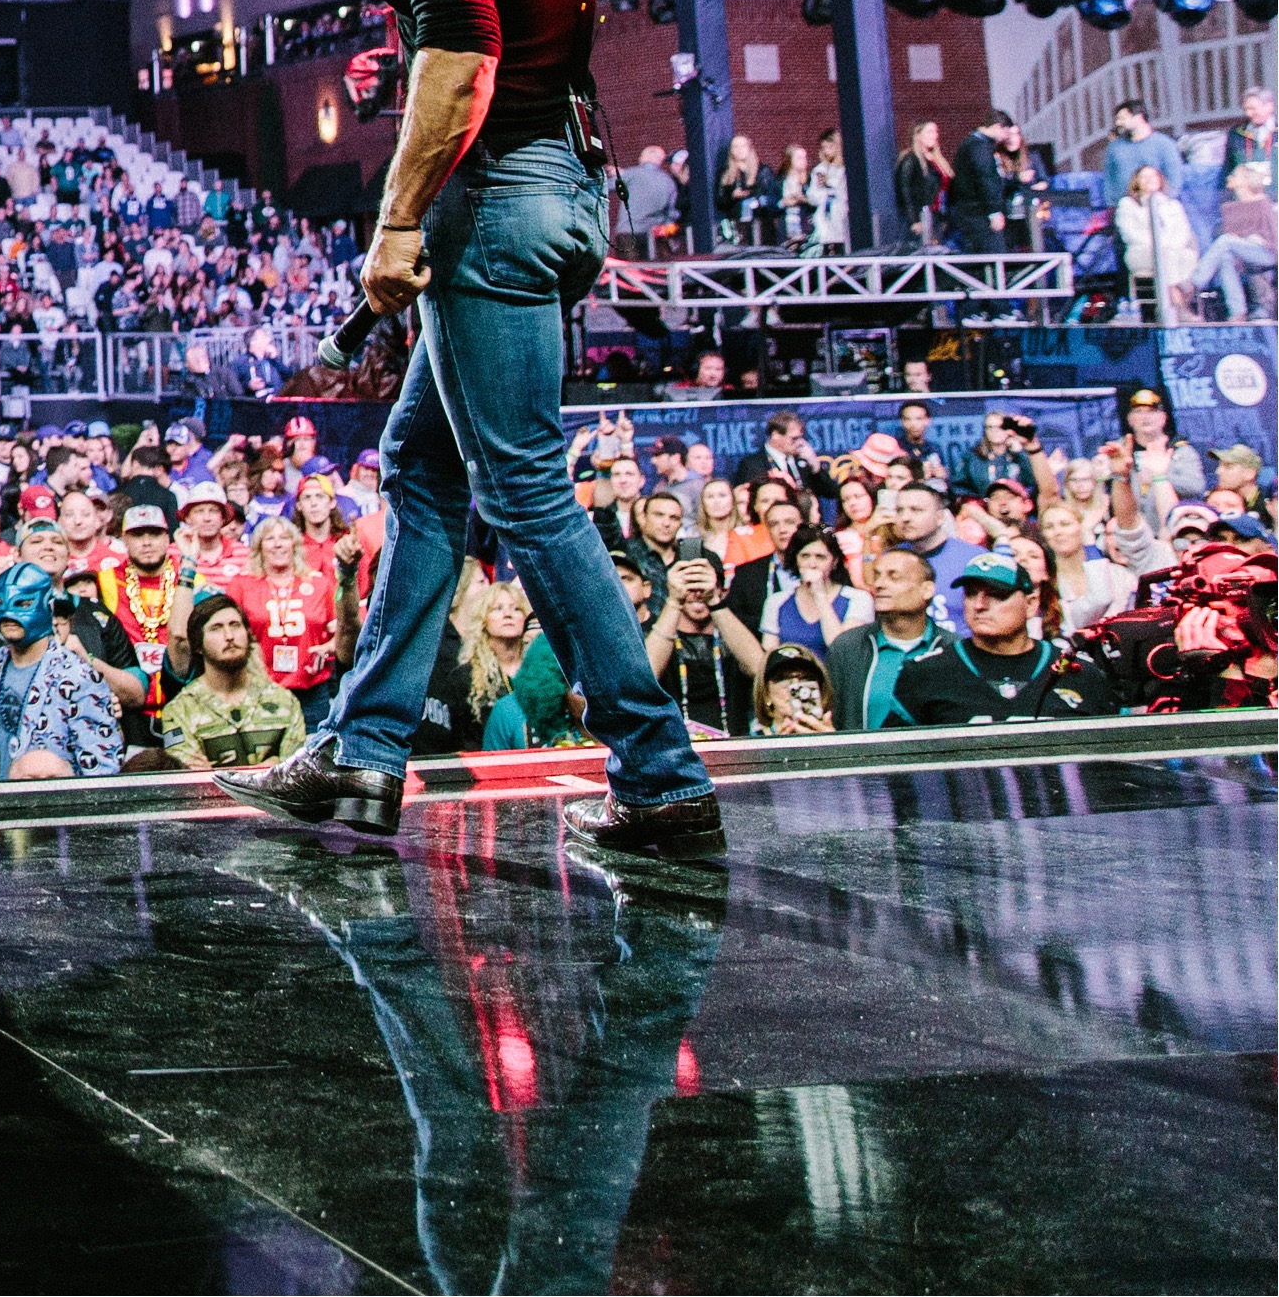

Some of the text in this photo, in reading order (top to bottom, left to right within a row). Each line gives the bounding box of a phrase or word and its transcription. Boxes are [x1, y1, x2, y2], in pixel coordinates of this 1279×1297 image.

[702, 416, 872, 454] TAKE STAGE
[266, 599, 307, 638] 15
